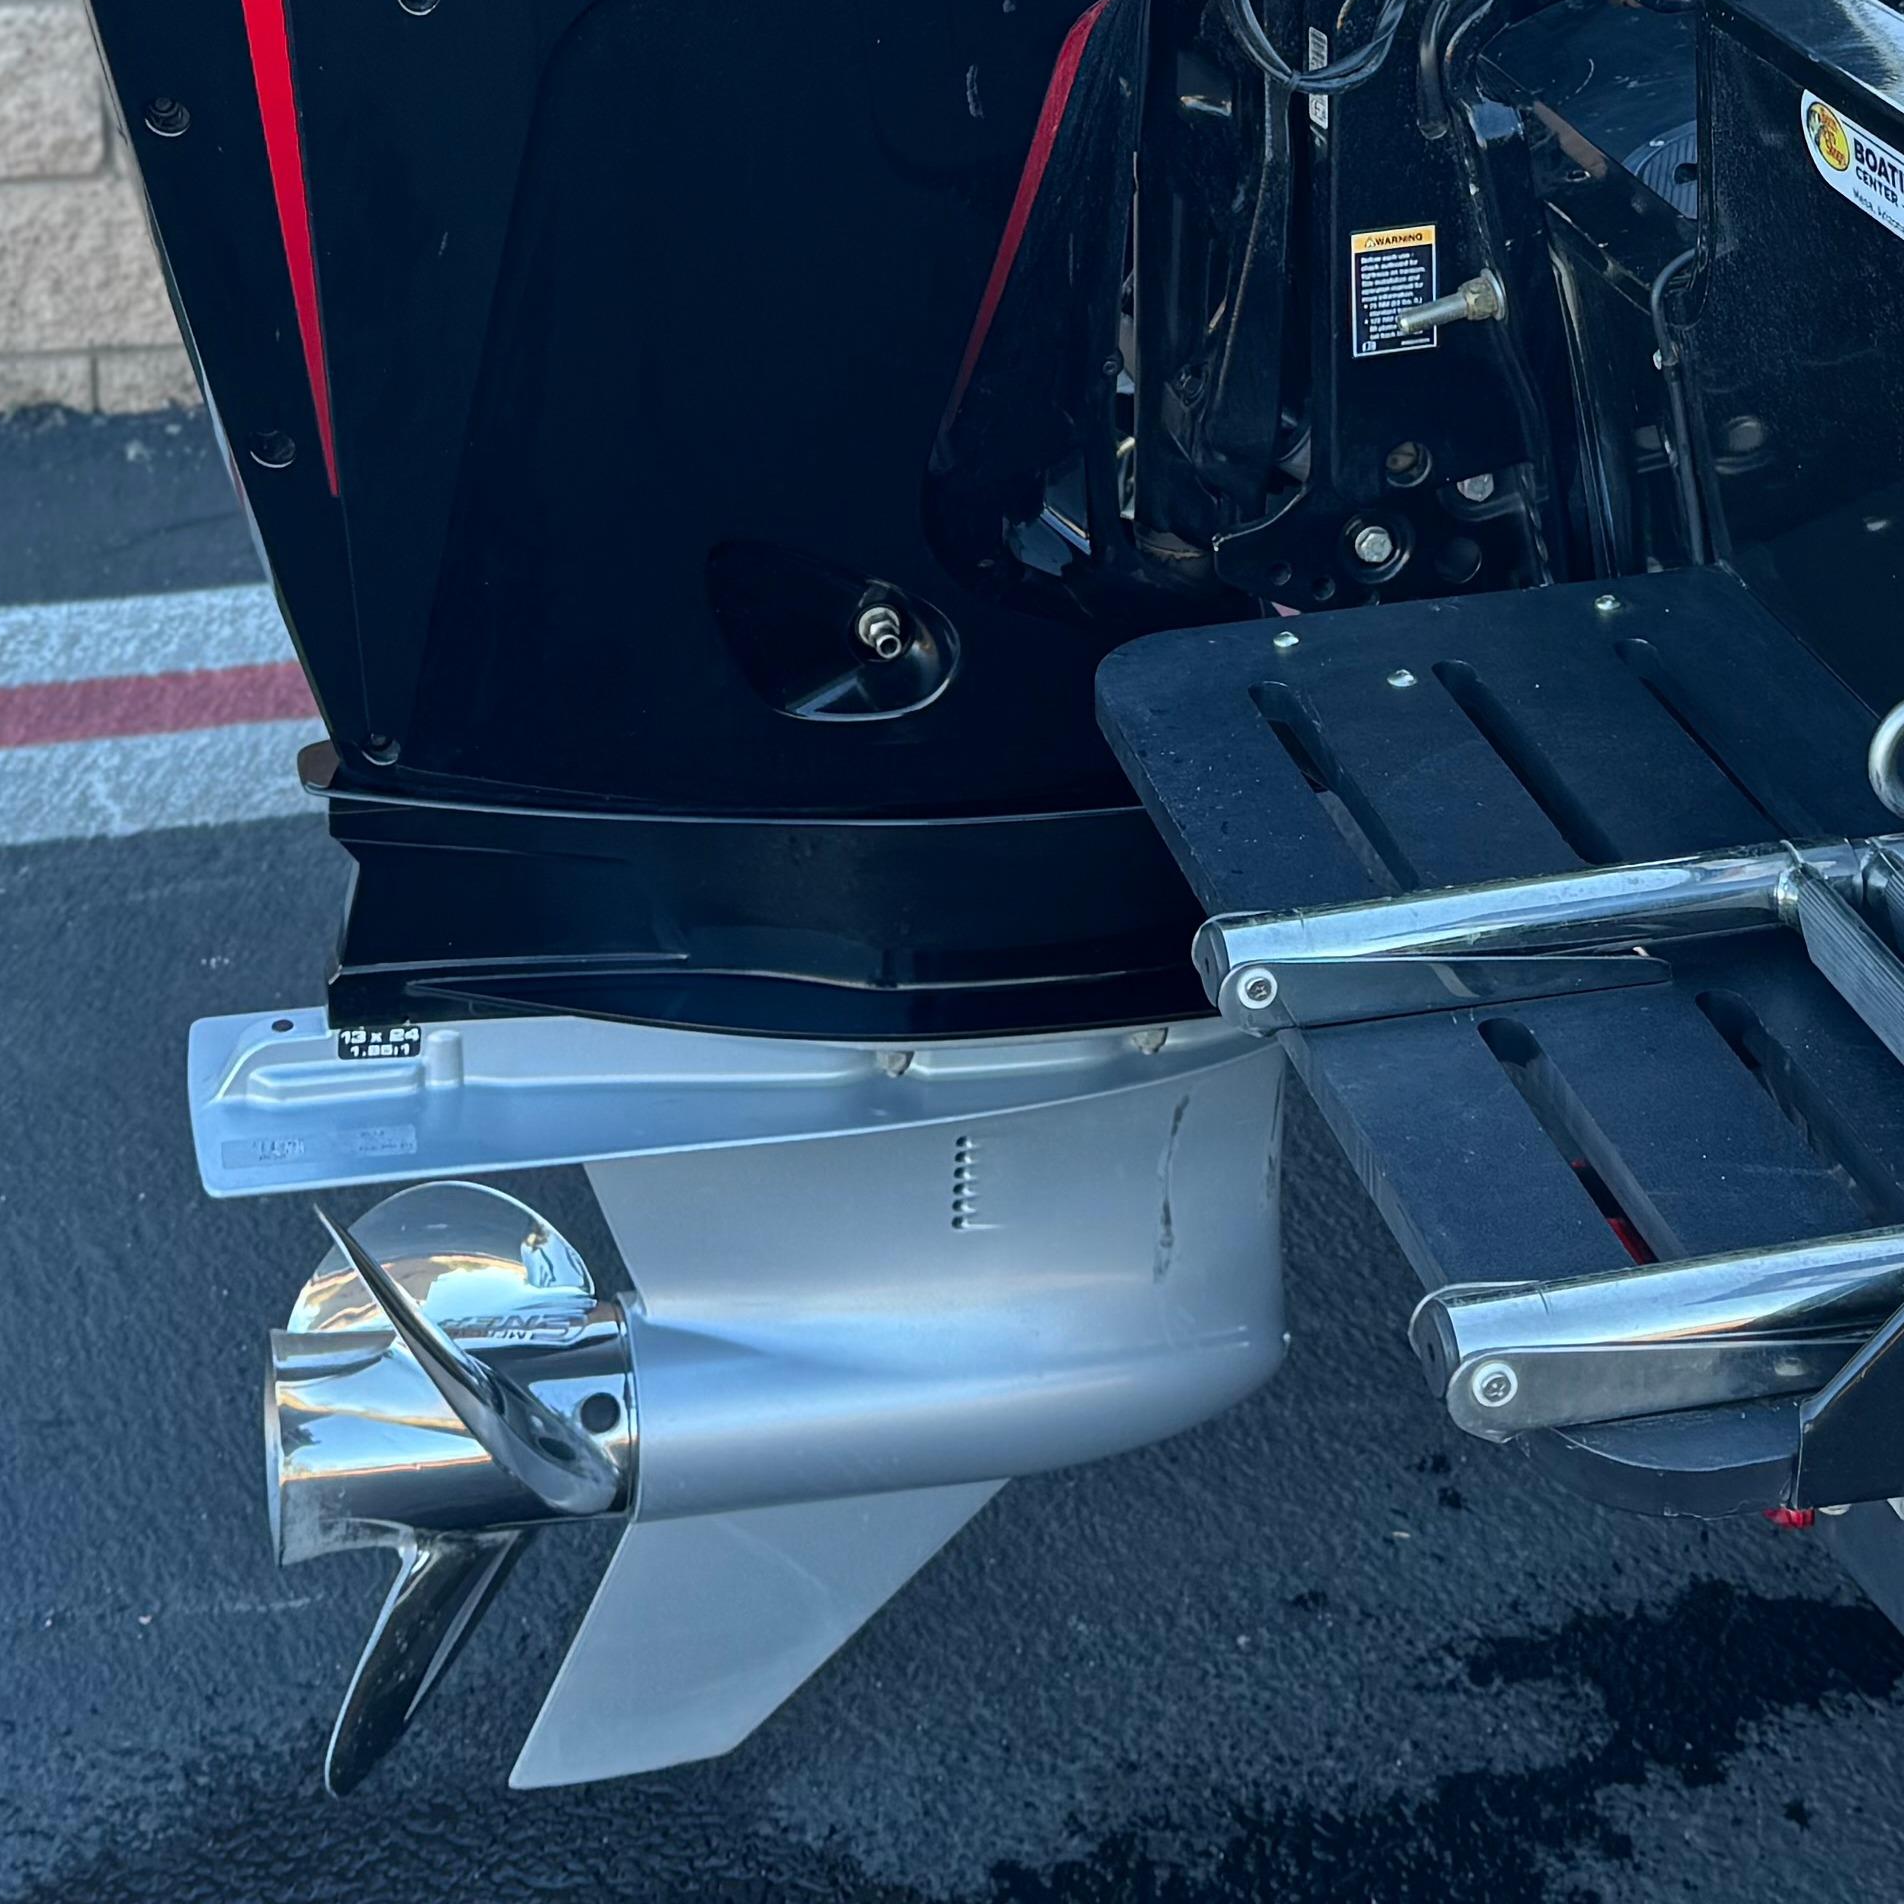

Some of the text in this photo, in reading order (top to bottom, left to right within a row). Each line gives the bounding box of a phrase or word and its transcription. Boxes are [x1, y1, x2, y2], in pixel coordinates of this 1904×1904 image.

[1856, 166, 1898, 207] CENTER
[1376, 233, 1423, 246] WARNING
[341, 1030, 366, 1044] 13
